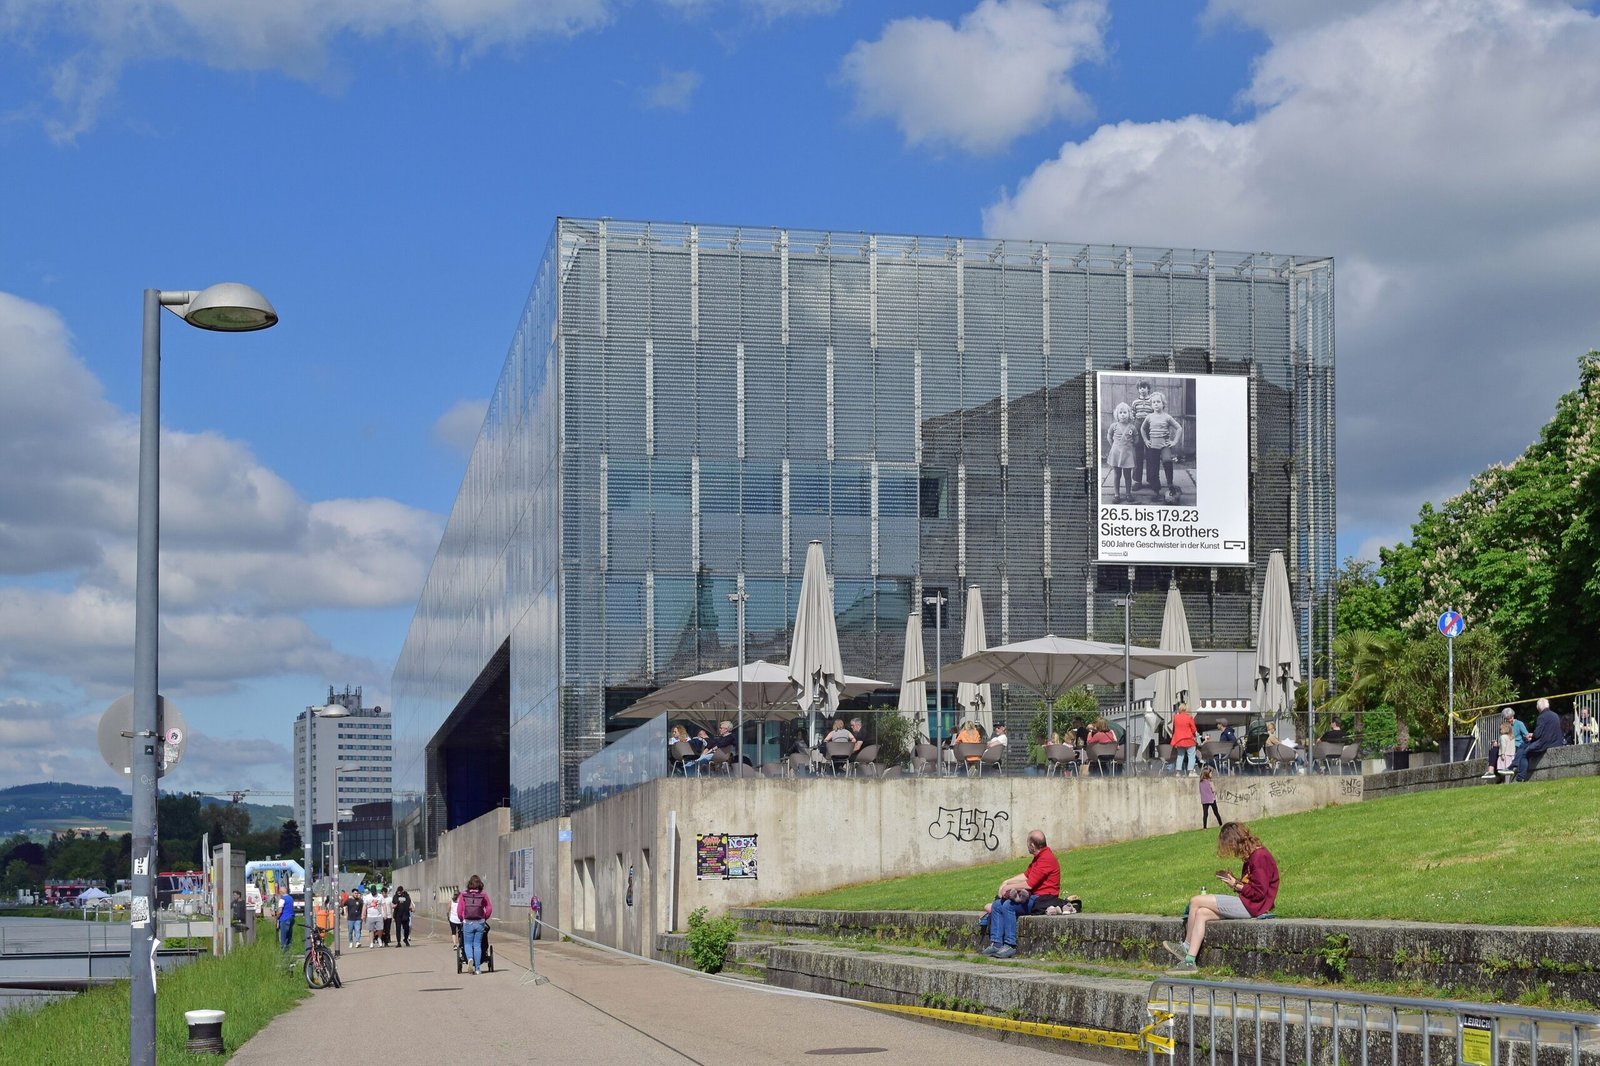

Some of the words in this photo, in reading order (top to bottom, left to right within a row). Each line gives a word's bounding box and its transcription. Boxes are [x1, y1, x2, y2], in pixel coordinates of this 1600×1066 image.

[1101, 507, 1132, 521] 26.5.
[1135, 508, 1154, 521] bis
[1156, 509, 1199, 523] 17.9.23
[1101, 522, 1147, 537] Sisters
[1149, 524, 1160, 537] &
[1162, 524, 1219, 538] Brothers
[1101, 540, 1115, 548] 500
[1116, 540, 1135, 548] Jahre
[1136, 540, 1179, 549] Geschwister
[1180, 541, 1186, 549] in
[1188, 541, 1199, 549] der
[1200, 542, 1220, 550] Kunst
[728, 837, 756, 848] NOFX
